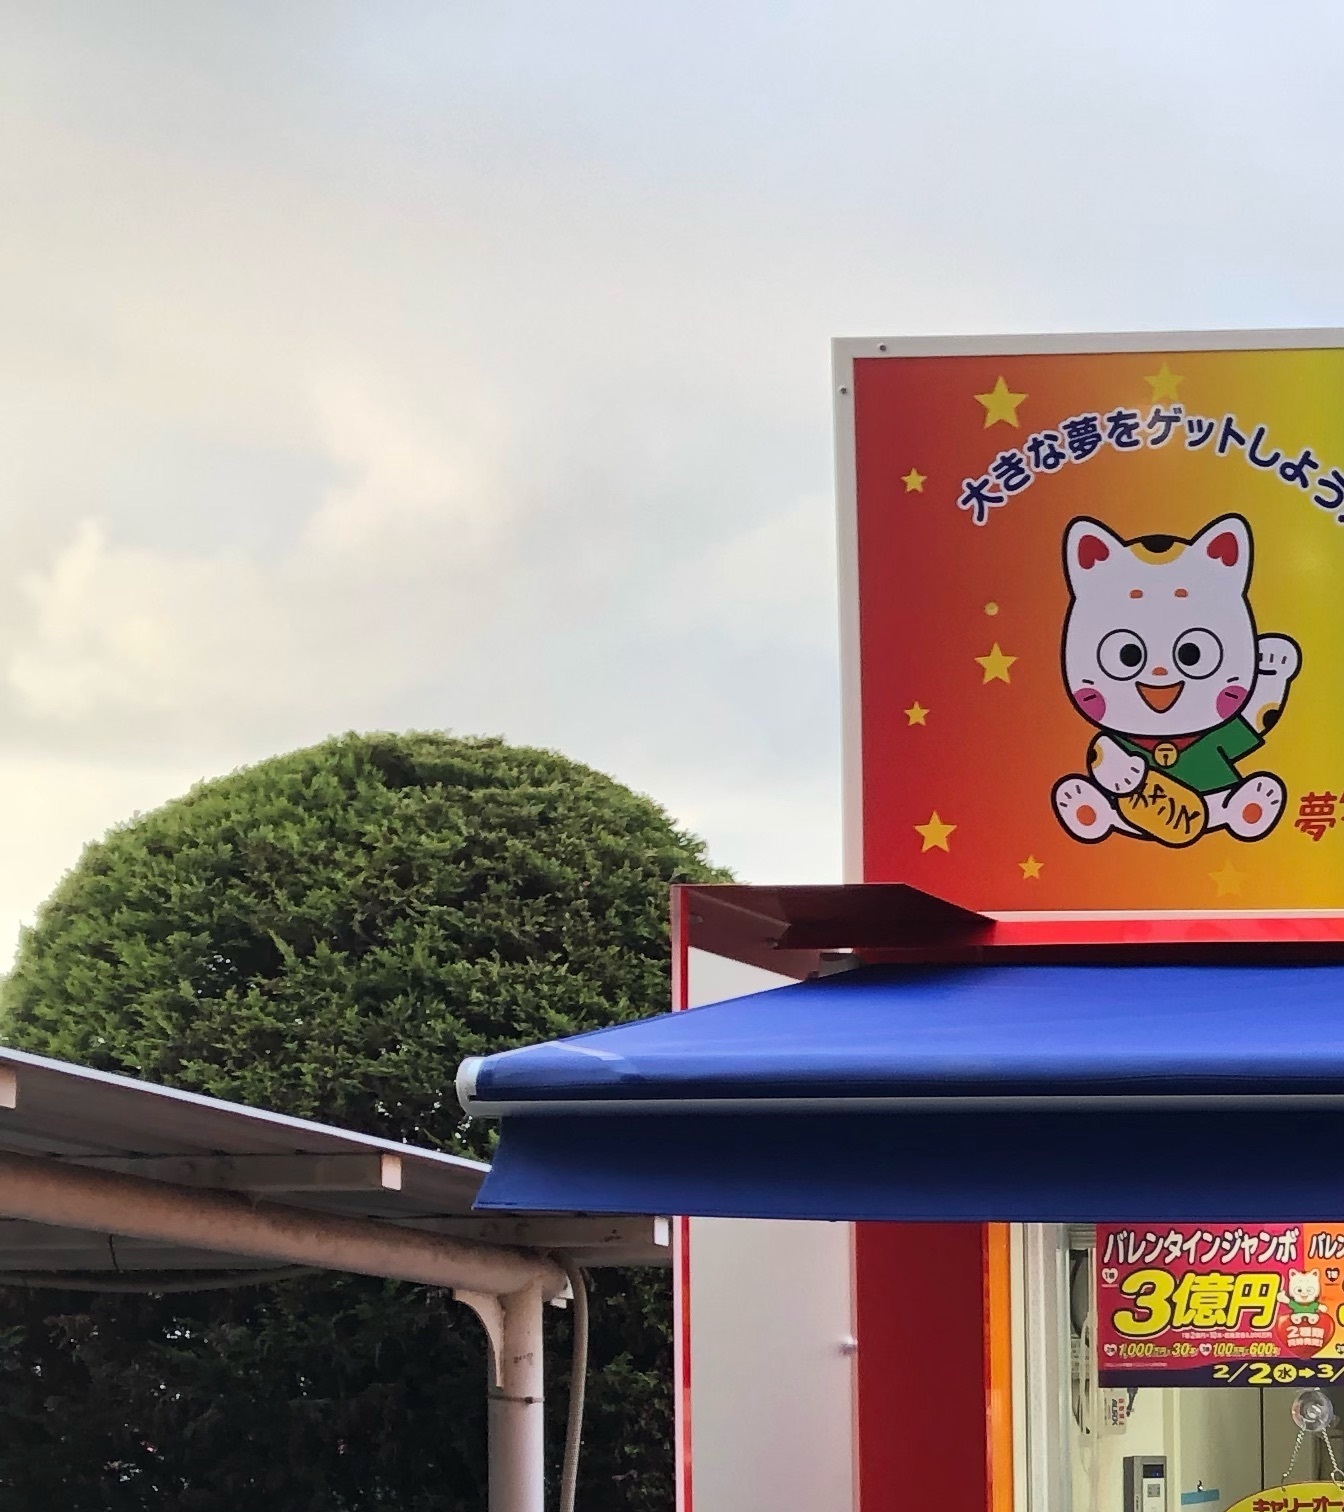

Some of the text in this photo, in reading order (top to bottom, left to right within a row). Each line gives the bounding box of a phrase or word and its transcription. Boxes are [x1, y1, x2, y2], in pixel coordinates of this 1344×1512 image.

[1103, 1228, 1299, 1264] バレンタインジャンボ
[1113, 1268, 1282, 1337] 3億円
